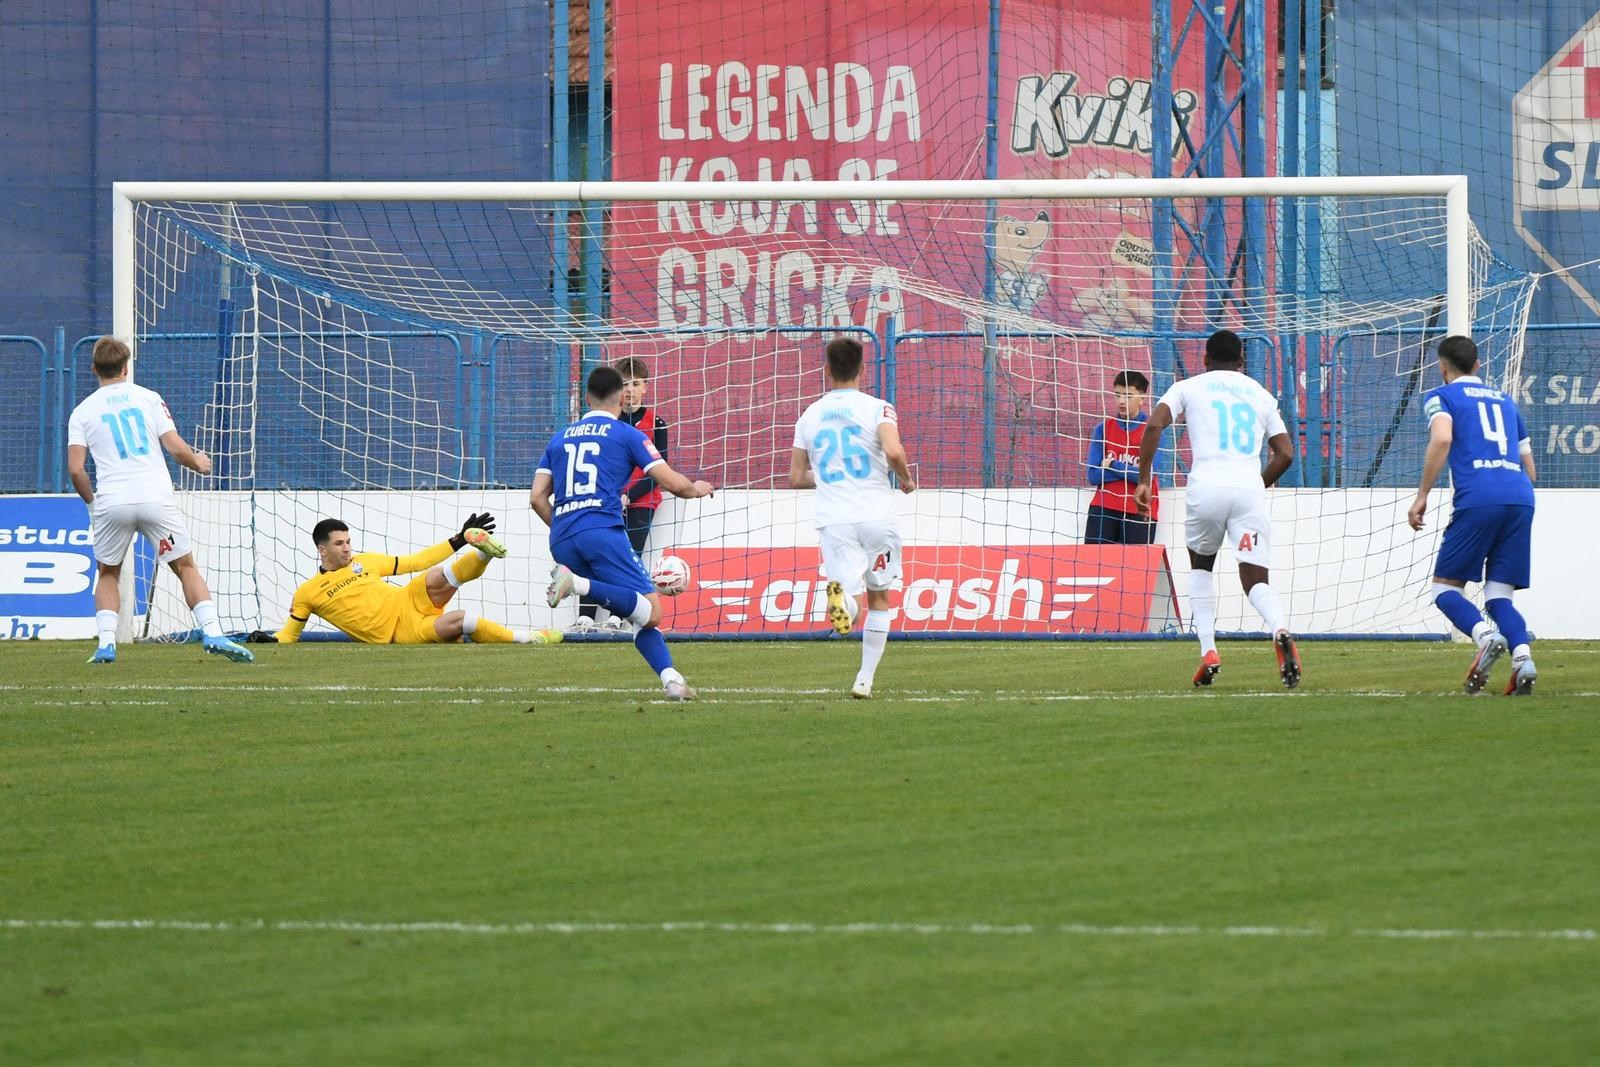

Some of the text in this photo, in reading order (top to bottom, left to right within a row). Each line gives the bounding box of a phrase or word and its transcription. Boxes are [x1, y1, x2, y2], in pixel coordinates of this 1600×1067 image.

[658, 60, 922, 143] LEGENDA
[657, 156, 900, 236] KOJA SE
[101, 408, 150, 460] 10
[813, 425, 871, 484] 26
[1211, 400, 1256, 455] 18
[1478, 401, 1508, 456] 4
[563, 441, 600, 498] 15
[158, 532, 175, 556] A1
[871, 550, 891, 572] A1
[1237, 532, 1258, 552] A1
[326, 575, 358, 598] Belupo
[759, 558, 1044, 622] aiash
